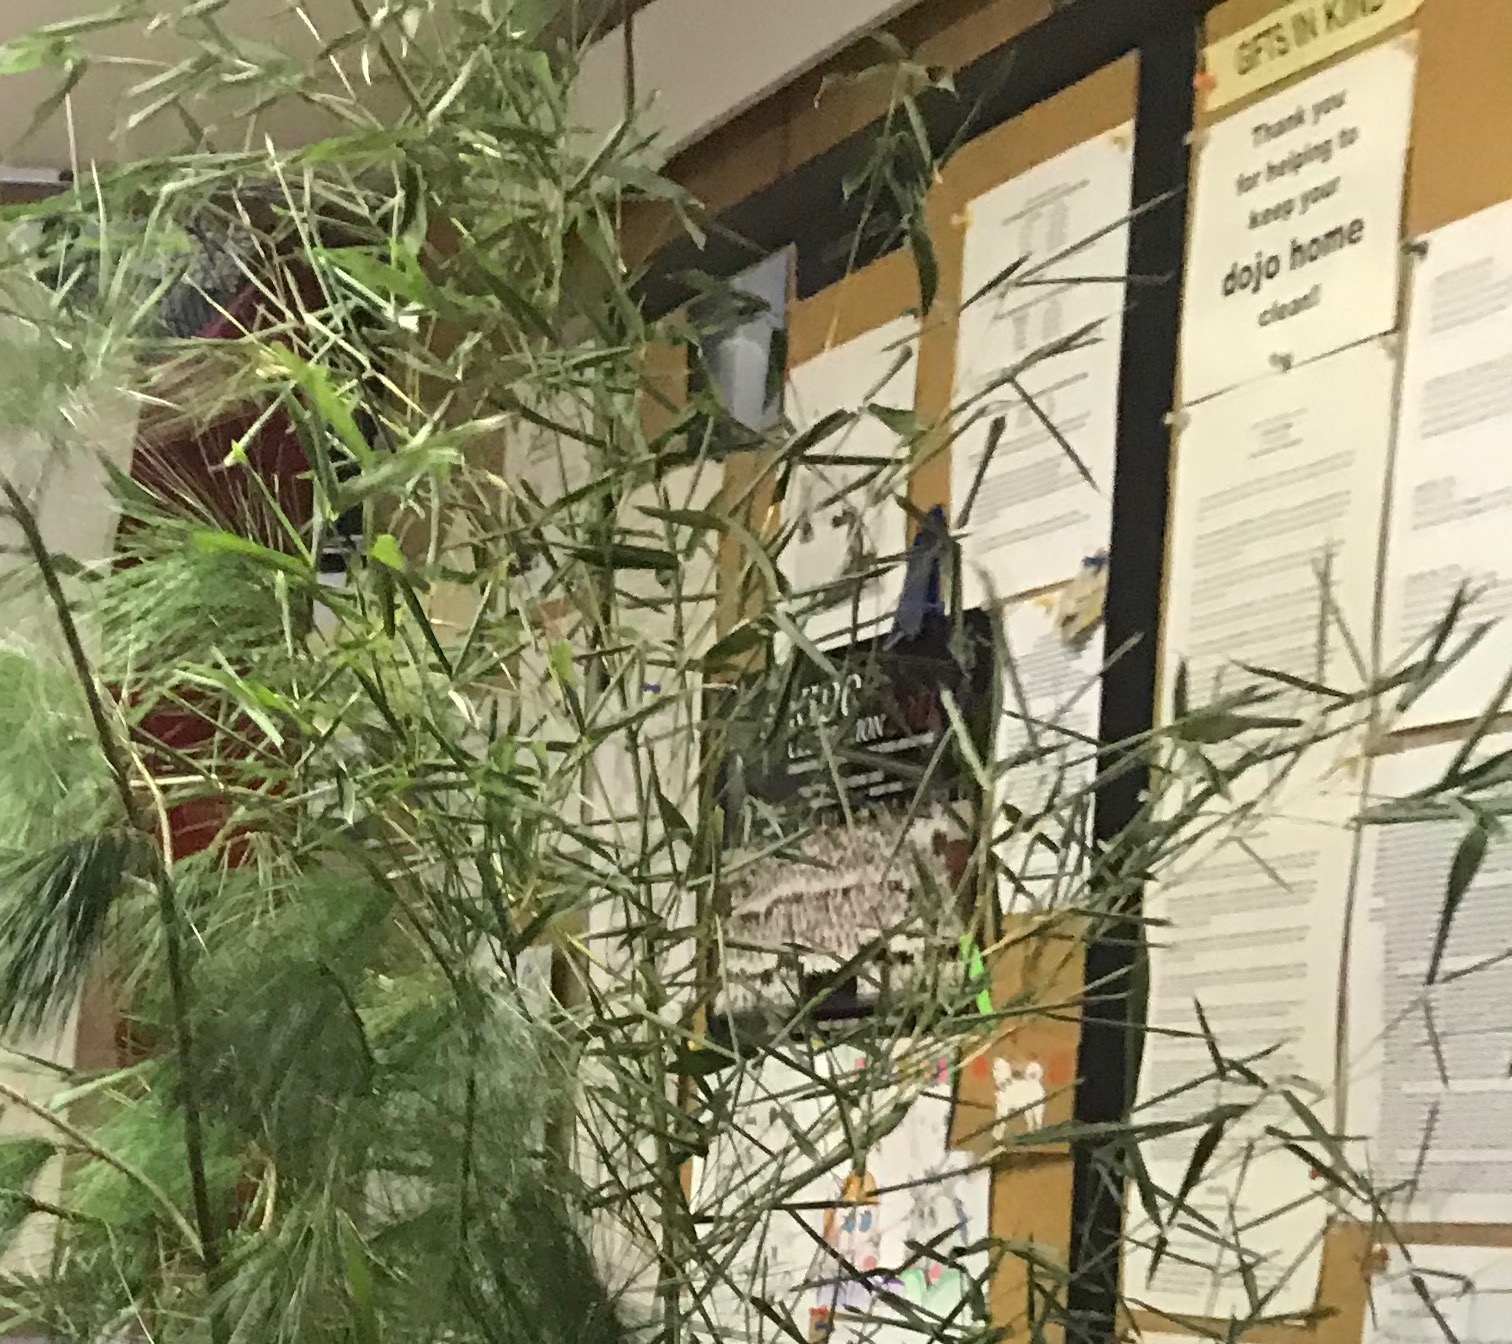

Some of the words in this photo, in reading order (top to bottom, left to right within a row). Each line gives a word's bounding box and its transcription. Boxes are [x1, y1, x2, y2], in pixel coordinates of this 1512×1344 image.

[1251, 104, 1306, 147] Thank
[1311, 88, 1348, 126] you
[1235, 170, 1263, 196] for
[1266, 138, 1334, 182] helping
[1339, 125, 1360, 149] to
[1248, 198, 1296, 230] keep
[1298, 175, 1342, 216] your
[1221, 249, 1281, 297] dojo
[1289, 217, 1365, 271] home
